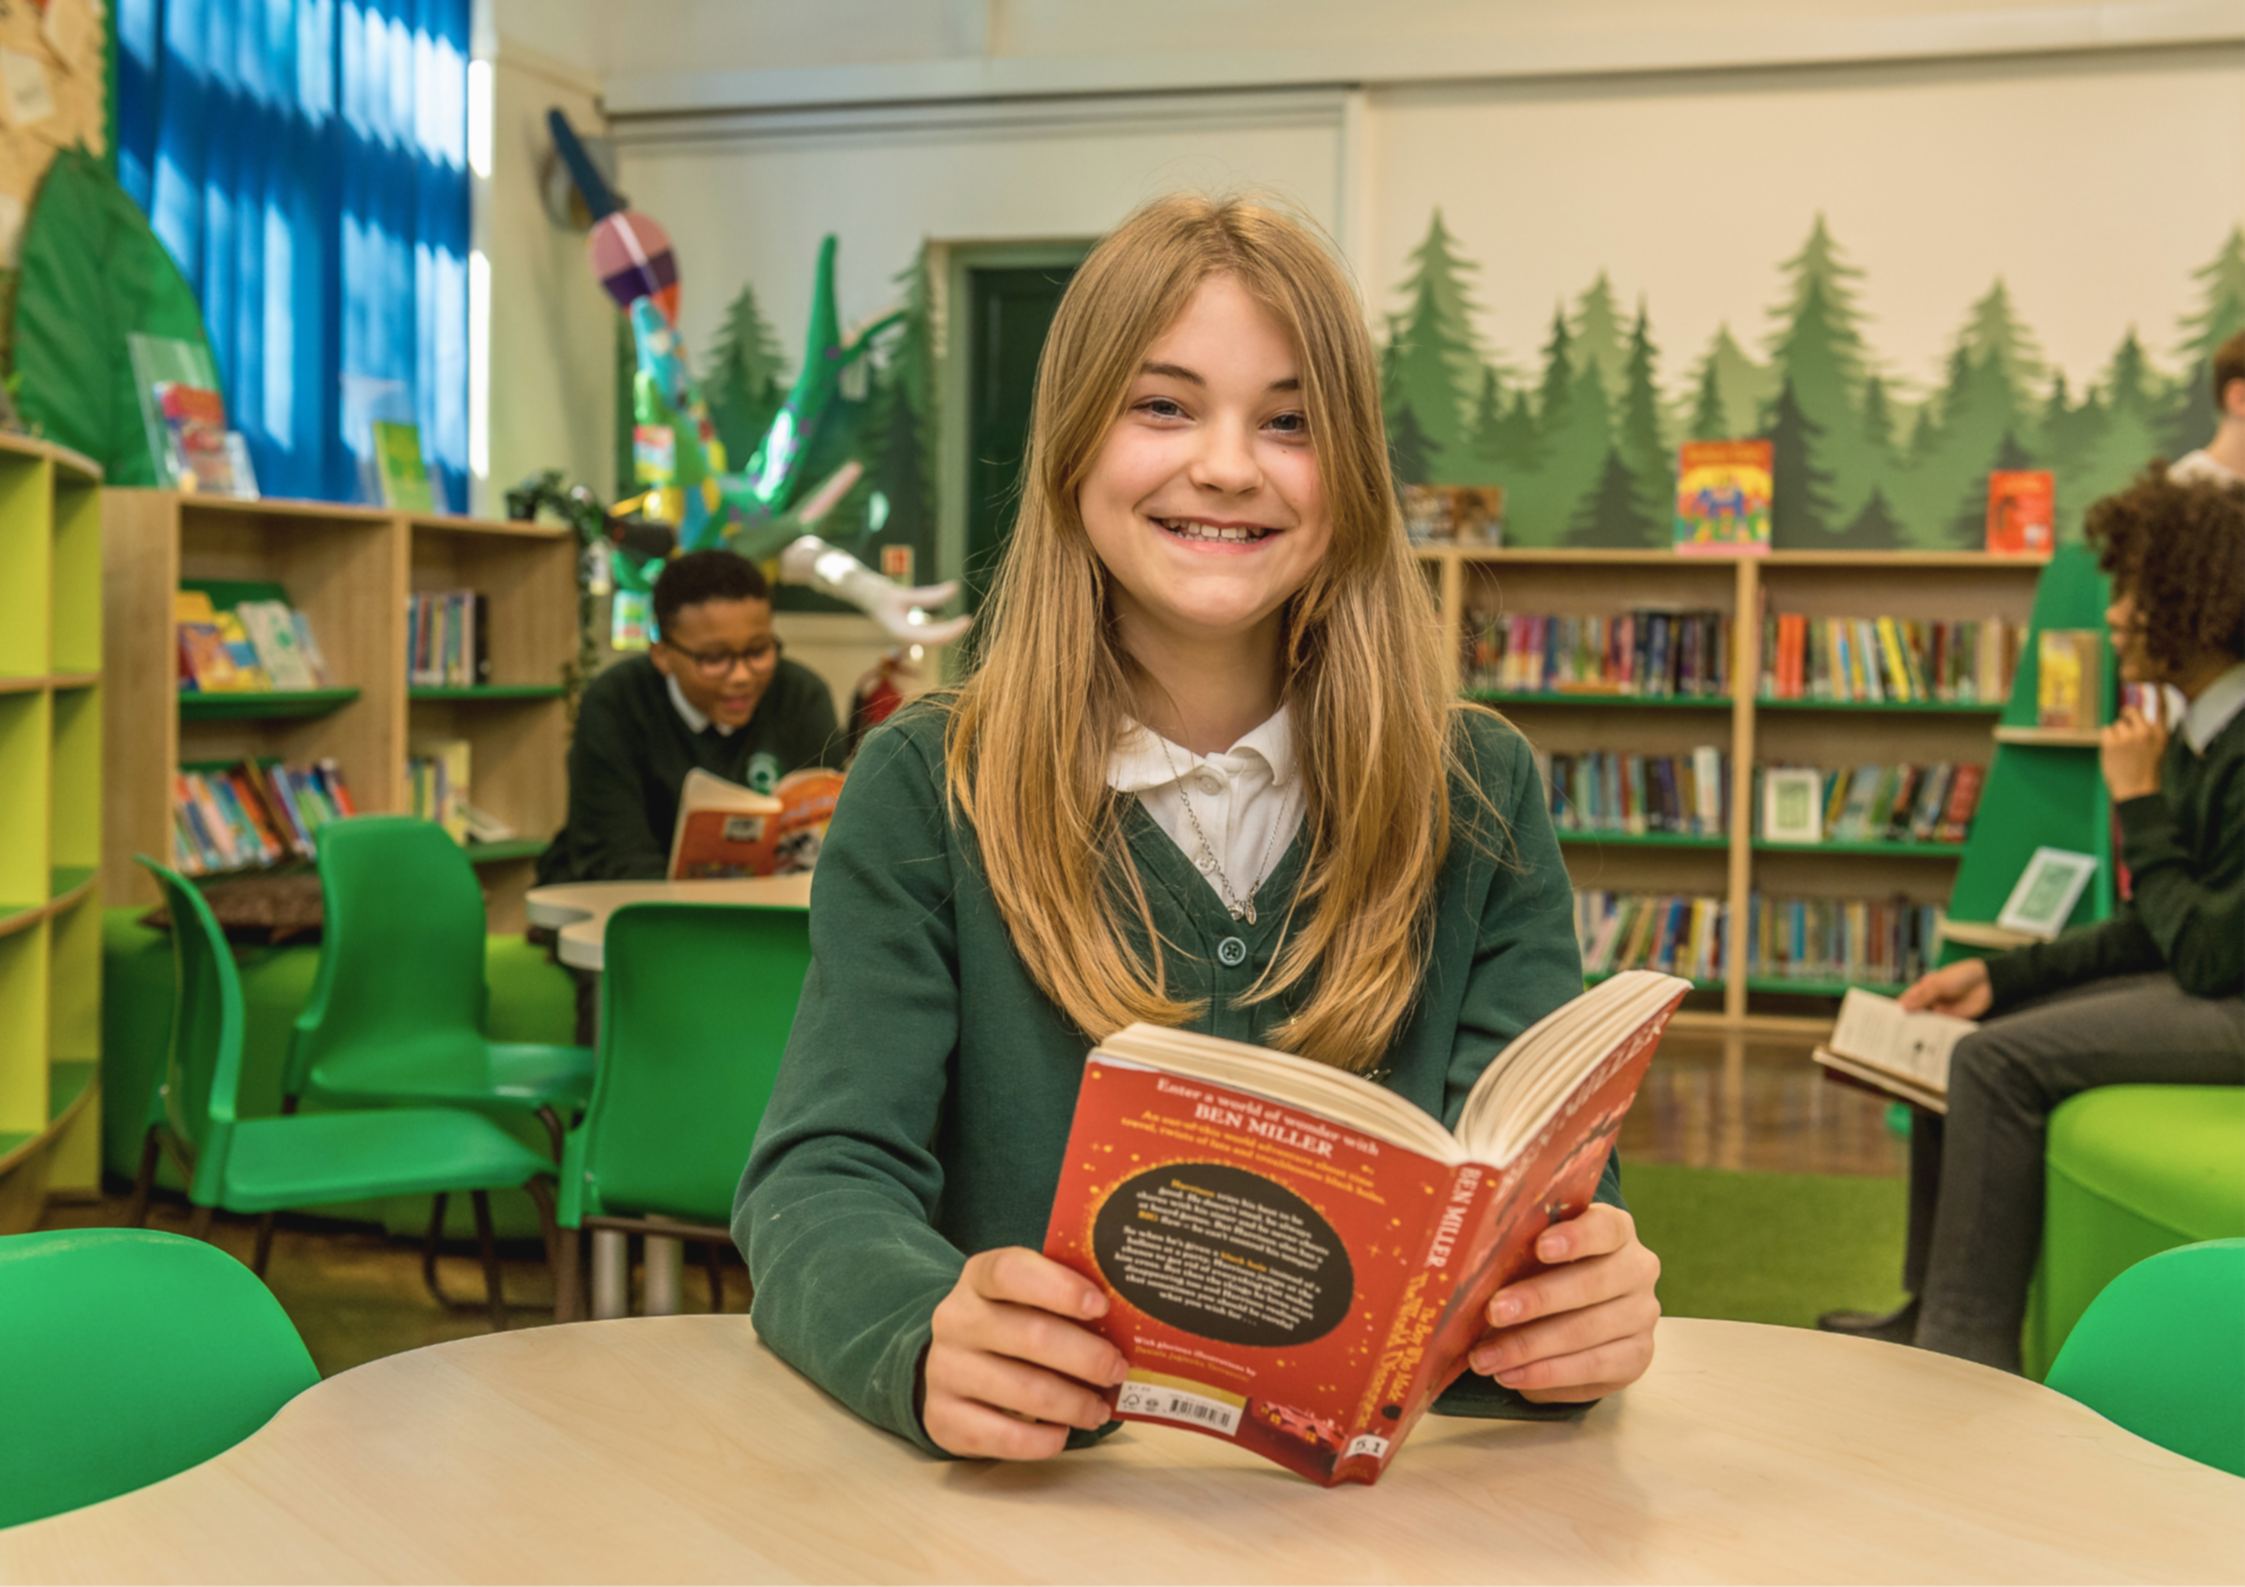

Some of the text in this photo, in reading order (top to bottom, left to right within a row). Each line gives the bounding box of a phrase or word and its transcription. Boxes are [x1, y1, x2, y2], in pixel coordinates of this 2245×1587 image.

[1557, 1011, 1669, 1131] MILLER
[1141, 1110, 1160, 1122] An
[1223, 1133, 1257, 1148] world
[1257, 1142, 1313, 1166] adventure
[1315, 1161, 1347, 1178] about
[1348, 1172, 1375, 1188] time
[1157, 1077, 1379, 1156] Enter a world of wonder with
[1194, 1103, 1333, 1159] BEN MILLER
[1159, 1126, 1194, 1142] twists
[1195, 1136, 1209, 1147] of
[1209, 1139, 1231, 1152] fate
[1232, 1146, 1254, 1159] and
[1255, 1153, 1323, 1181] troublesome
[1325, 1174, 1354, 1193] black
[1423, 1167, 1483, 1268] BEN MILLER
[1133, 1335, 1257, 1377] With glorious illustrations by
[1355, 1440, 1382, 1454] 5.1
